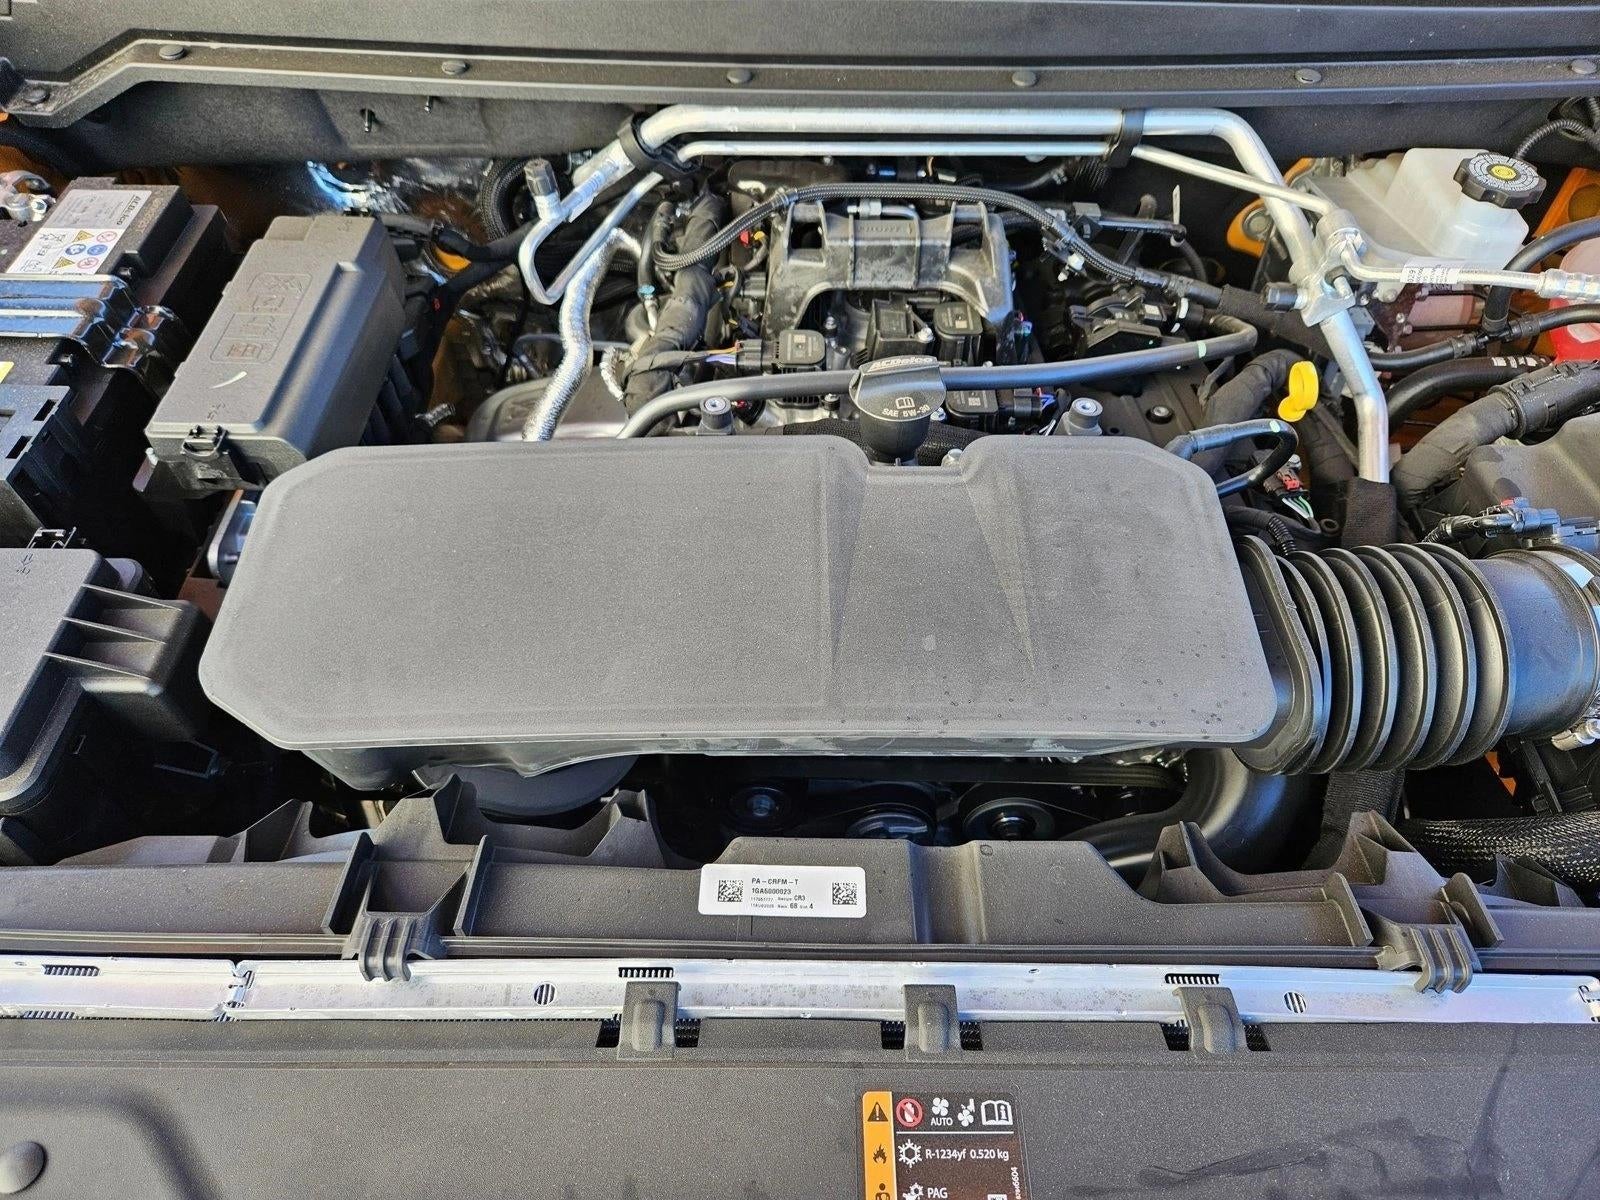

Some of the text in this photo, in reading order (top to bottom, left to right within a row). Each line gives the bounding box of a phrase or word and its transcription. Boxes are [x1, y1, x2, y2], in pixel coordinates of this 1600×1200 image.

[867, 357, 933, 372] ACDelco
[882, 404, 930, 417] SAE 5W-30
[930, 1117, 953, 1126] AUTO
[925, 1148, 1009, 1161] R-1234yf 0.520 kg
[927, 1187, 948, 1198] PAG
